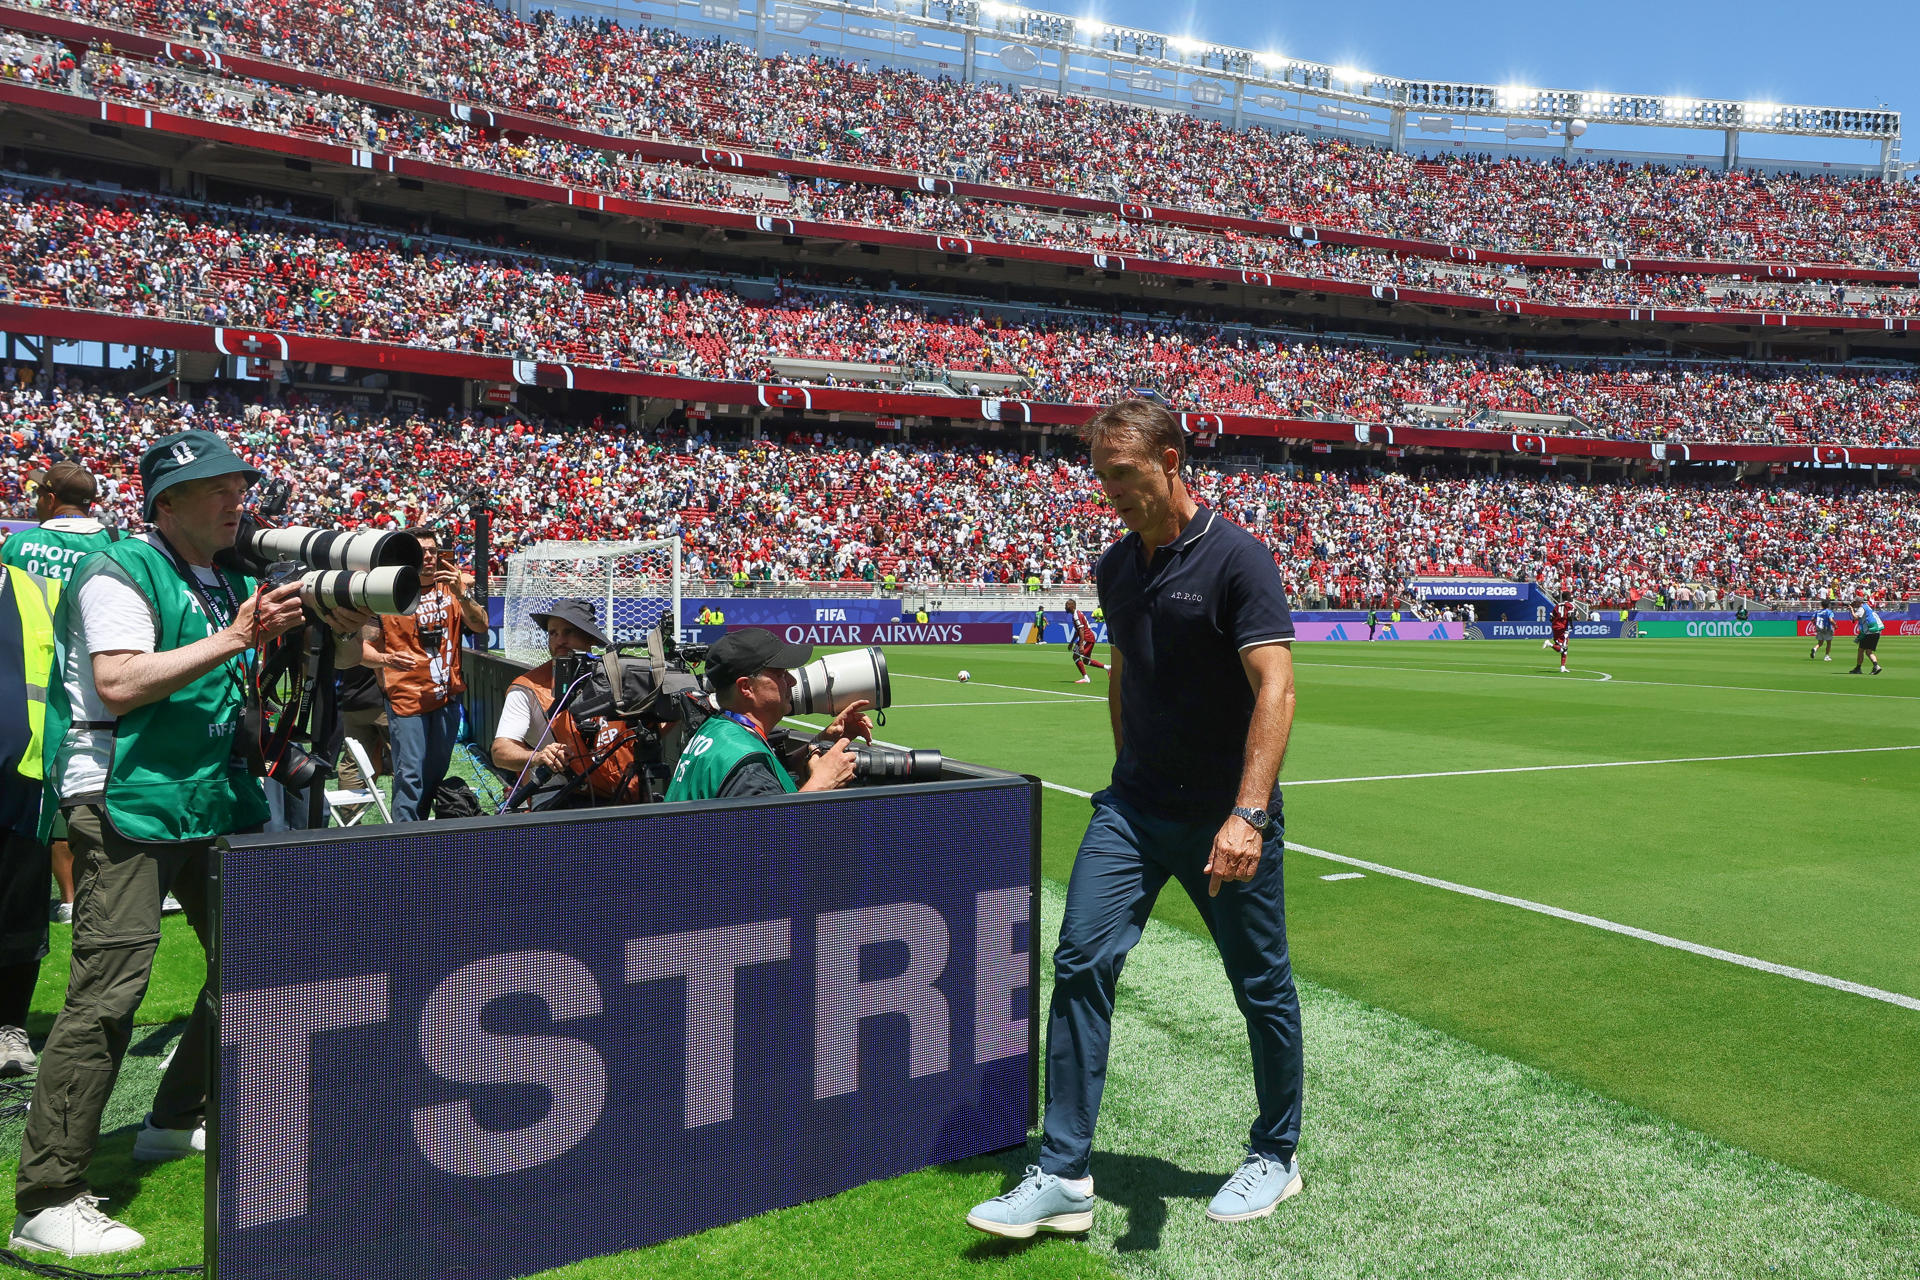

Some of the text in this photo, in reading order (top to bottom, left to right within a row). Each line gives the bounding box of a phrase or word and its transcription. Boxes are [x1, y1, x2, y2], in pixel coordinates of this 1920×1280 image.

[1433, 586, 1466, 596] WORLD
[1467, 586, 1485, 596] CUP
[1486, 586, 1517, 596] 2026
[816, 608, 847, 621] FIFA
[785, 625, 963, 644] QATAR AIRWAYS
[1493, 625, 1608, 636] FIFA WORLD 2026
[1686, 621, 1753, 636] aramco
